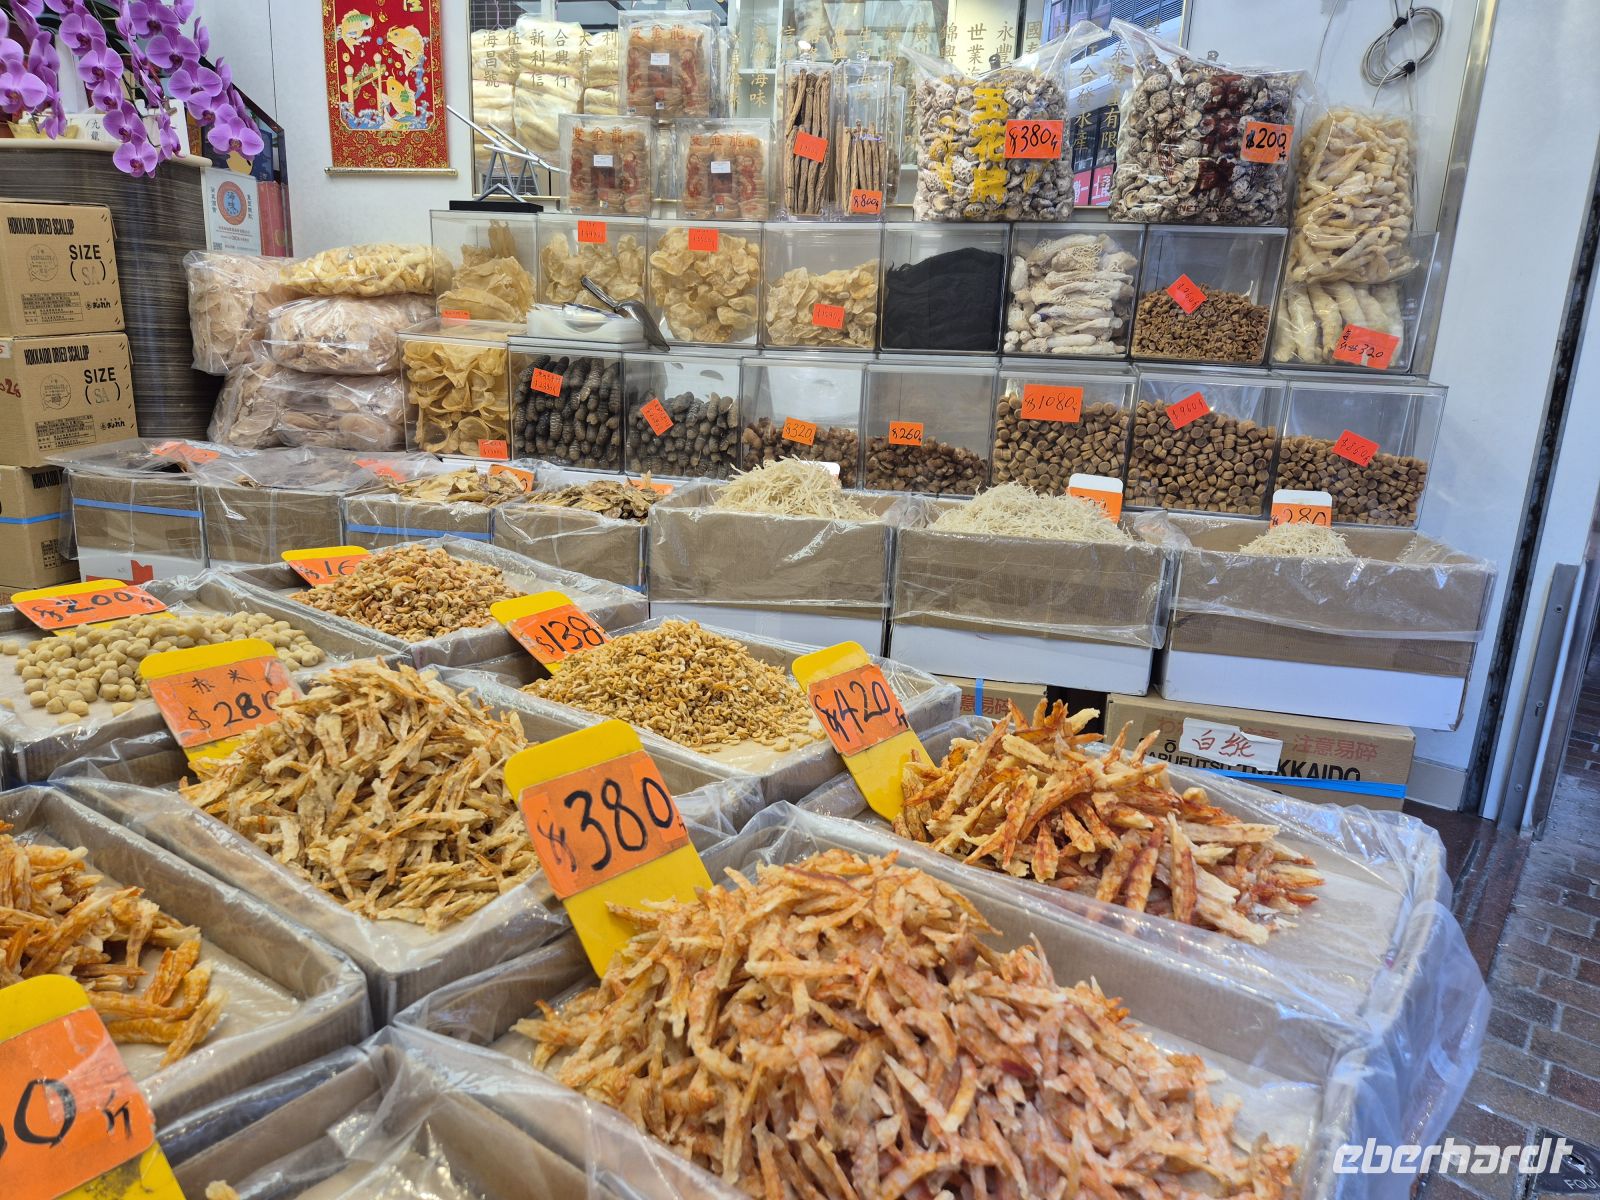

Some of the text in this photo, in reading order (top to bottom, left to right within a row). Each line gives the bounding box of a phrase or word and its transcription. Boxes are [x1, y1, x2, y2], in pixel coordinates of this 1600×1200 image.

[529, 28, 546, 88] 新利信
[1008, 123, 1052, 155] $380
[7, 217, 36, 234] HOKKAIDO
[69, 244, 102, 260] SIZE
[24, 348, 52, 366] HOKKAIDO
[83, 367, 117, 384] SIZE
[814, 680, 891, 742] $420
[536, 776, 675, 874] $380
